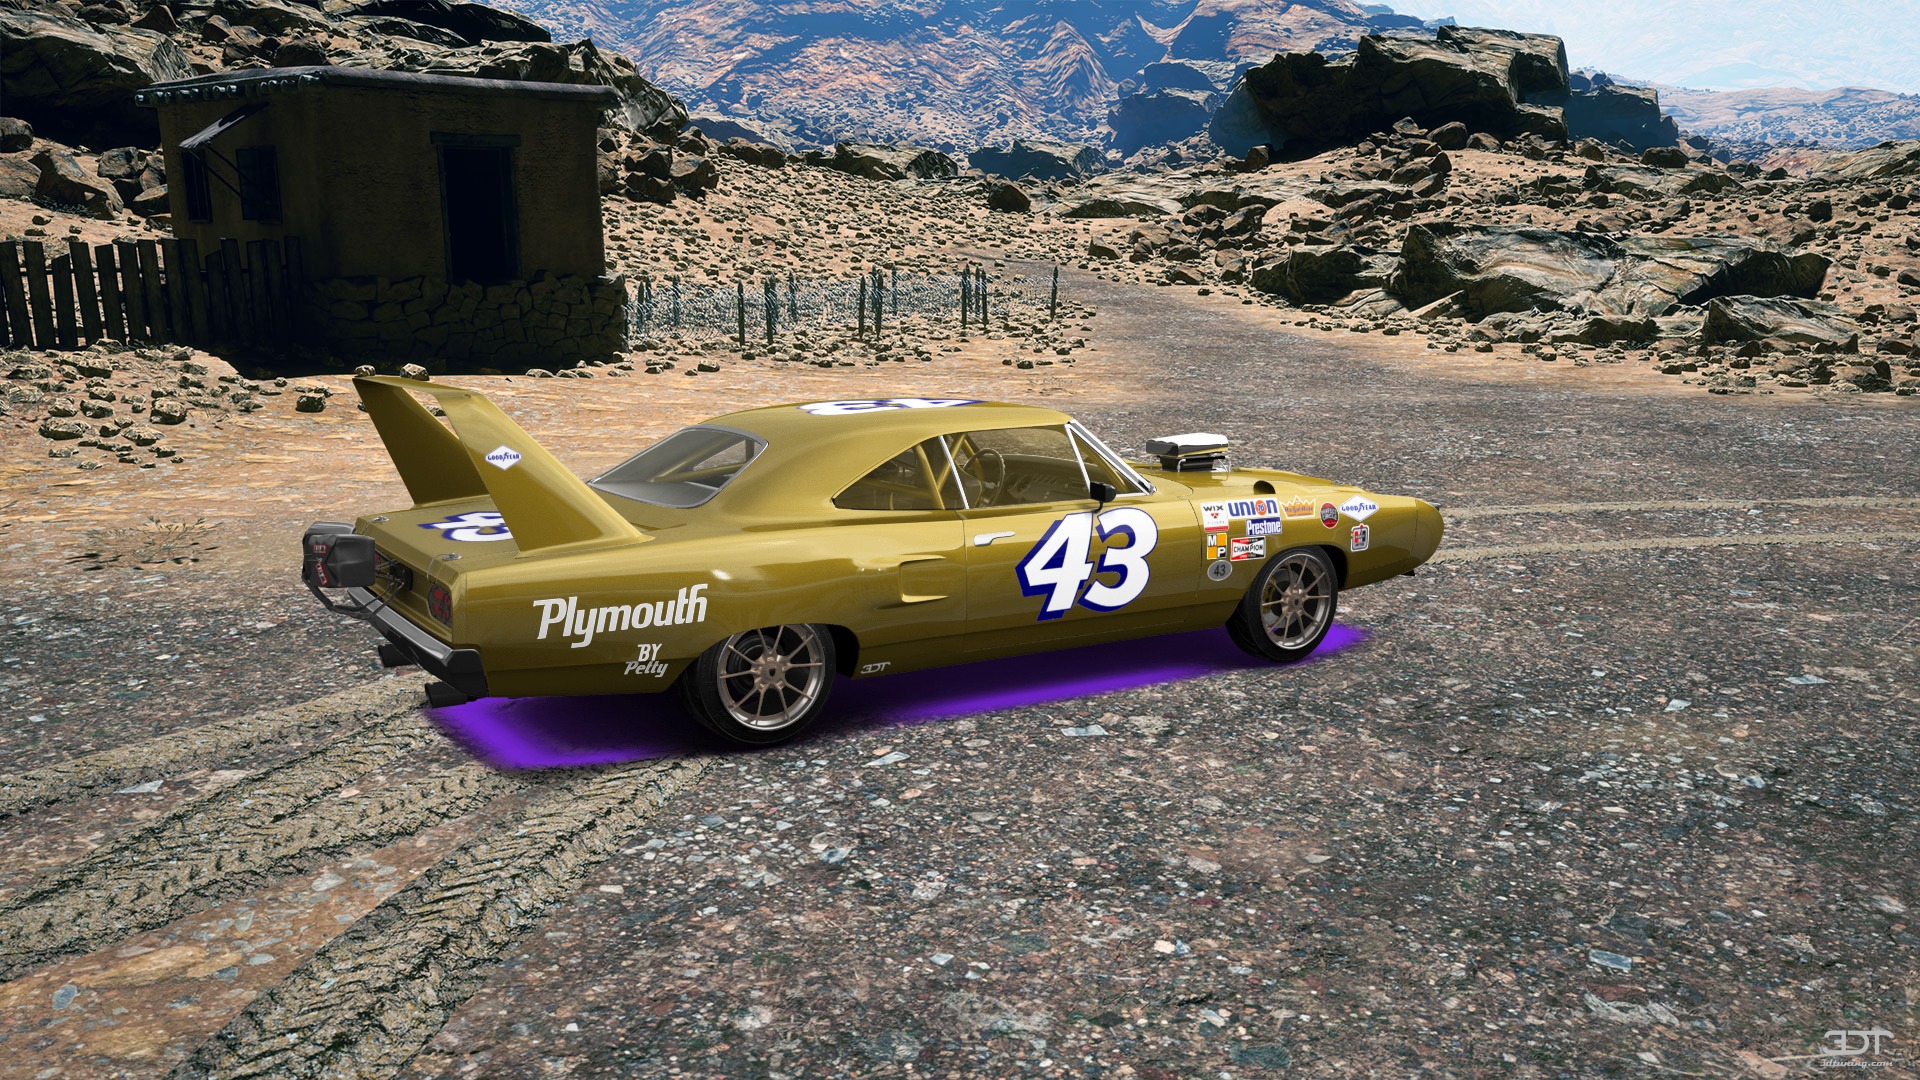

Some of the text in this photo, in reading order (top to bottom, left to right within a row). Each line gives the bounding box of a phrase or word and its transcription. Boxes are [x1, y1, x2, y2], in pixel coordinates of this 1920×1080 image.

[487, 452, 520, 462] GOODYEAR
[1342, 502, 1377, 513] GOODYEAR
[1246, 519, 1282, 536] Prestone
[1208, 534, 1218, 547] M
[1217, 546, 1227, 558] P
[1233, 543, 1264, 553] CHAMPION
[1015, 506, 1159, 622] 43
[1213, 564, 1227, 577] 43
[533, 583, 709, 649] Plymouth
[637, 643, 662, 662] BY
[623, 660, 669, 678] Petty
